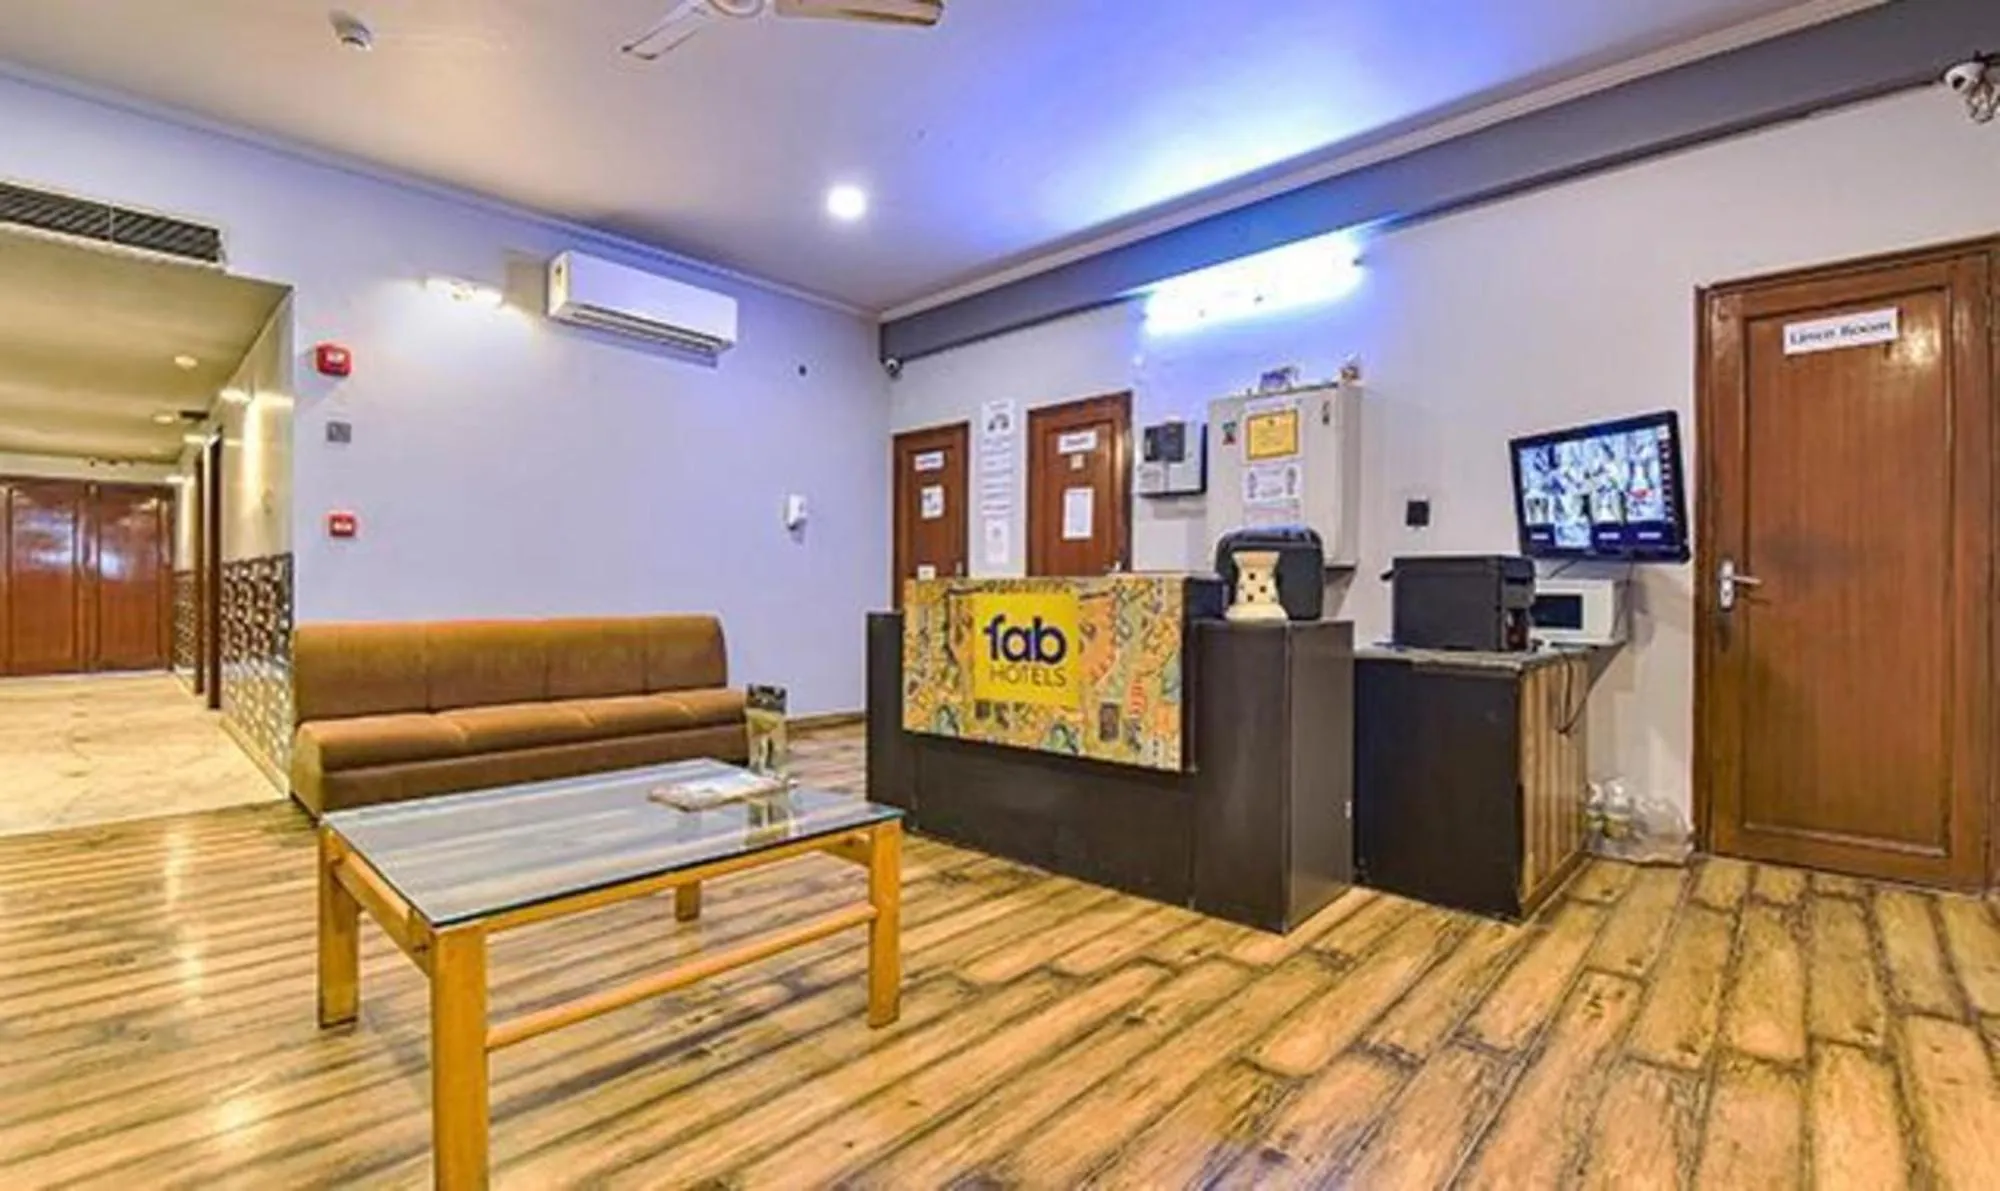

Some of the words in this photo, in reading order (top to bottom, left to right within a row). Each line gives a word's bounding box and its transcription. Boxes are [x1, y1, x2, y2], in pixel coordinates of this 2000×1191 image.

[1840, 320, 1892, 337] Room
[983, 613, 1067, 665] fab
[989, 664, 1067, 688] HOTELS
